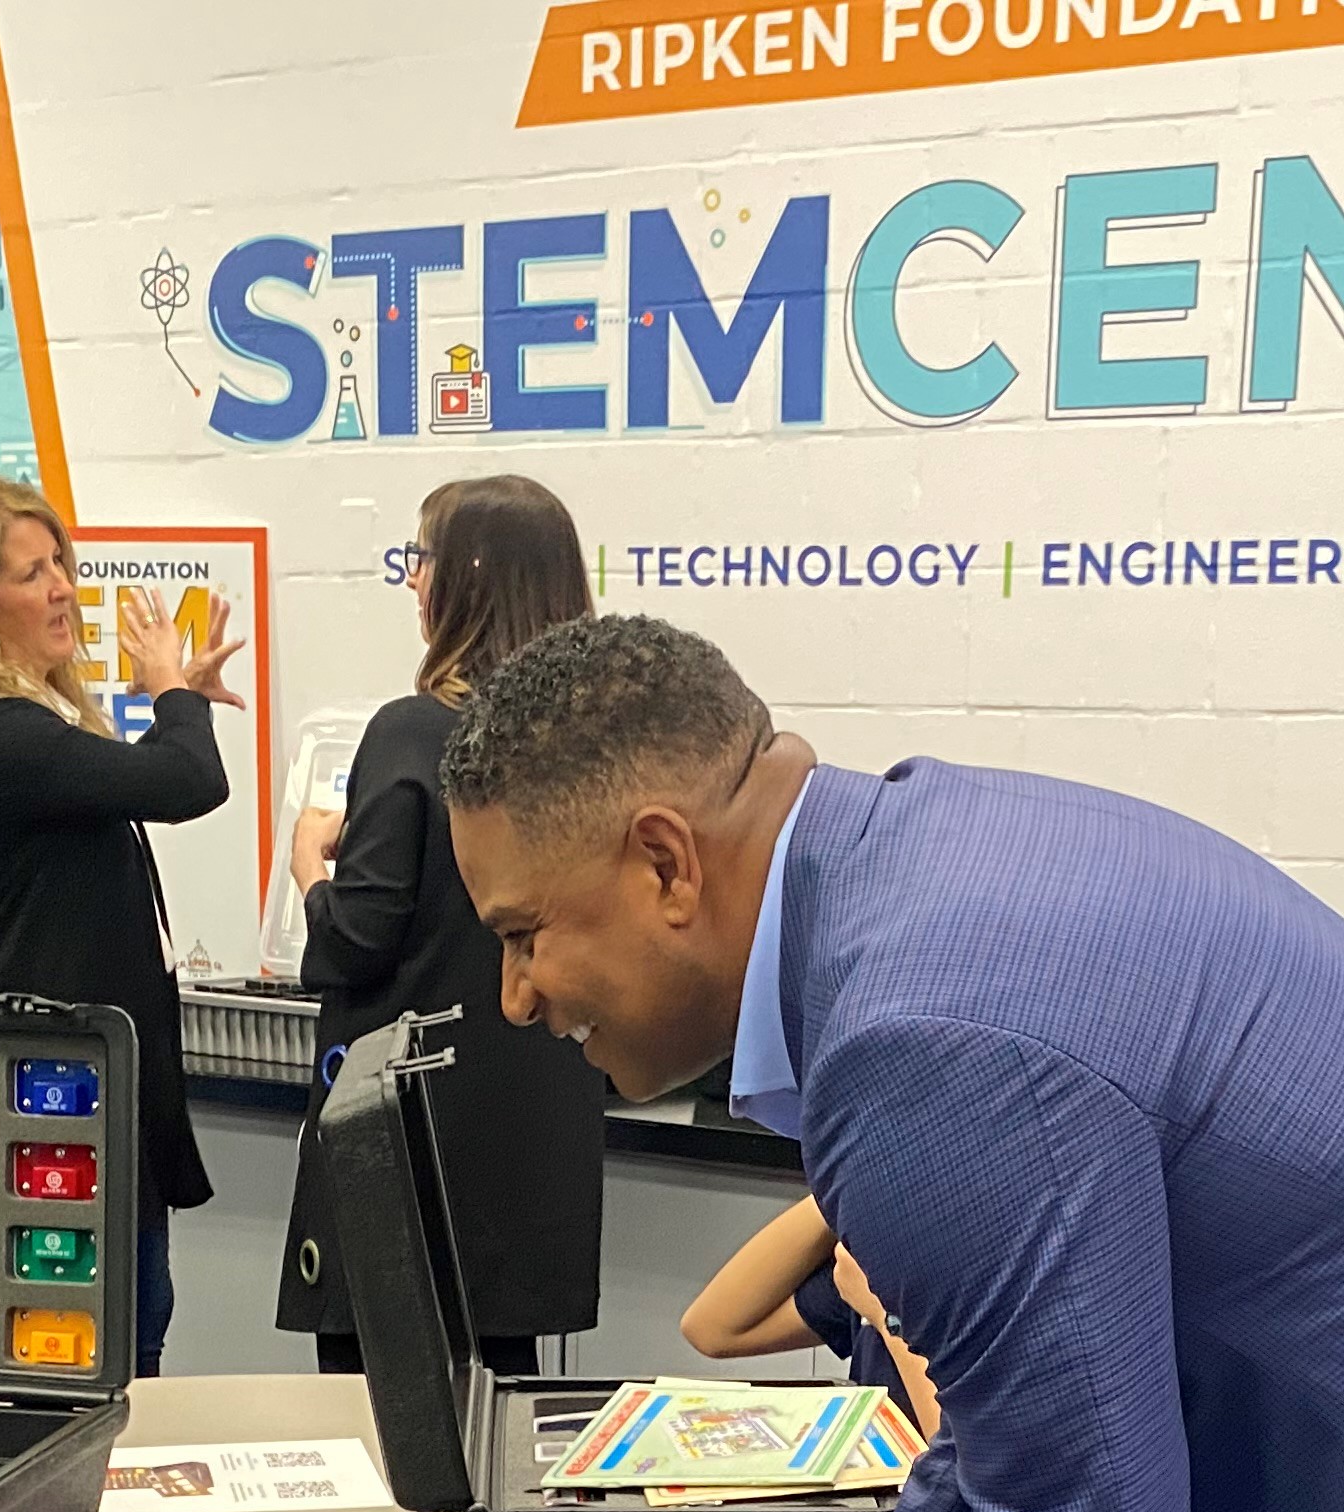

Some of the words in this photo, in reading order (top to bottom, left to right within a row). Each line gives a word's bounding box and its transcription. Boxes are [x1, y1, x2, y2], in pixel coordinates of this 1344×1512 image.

[581, 3, 850, 94] RIPKEN
[78, 561, 210, 579] OUNDATION
[626, 543, 980, 587] TECHNOLOGY
